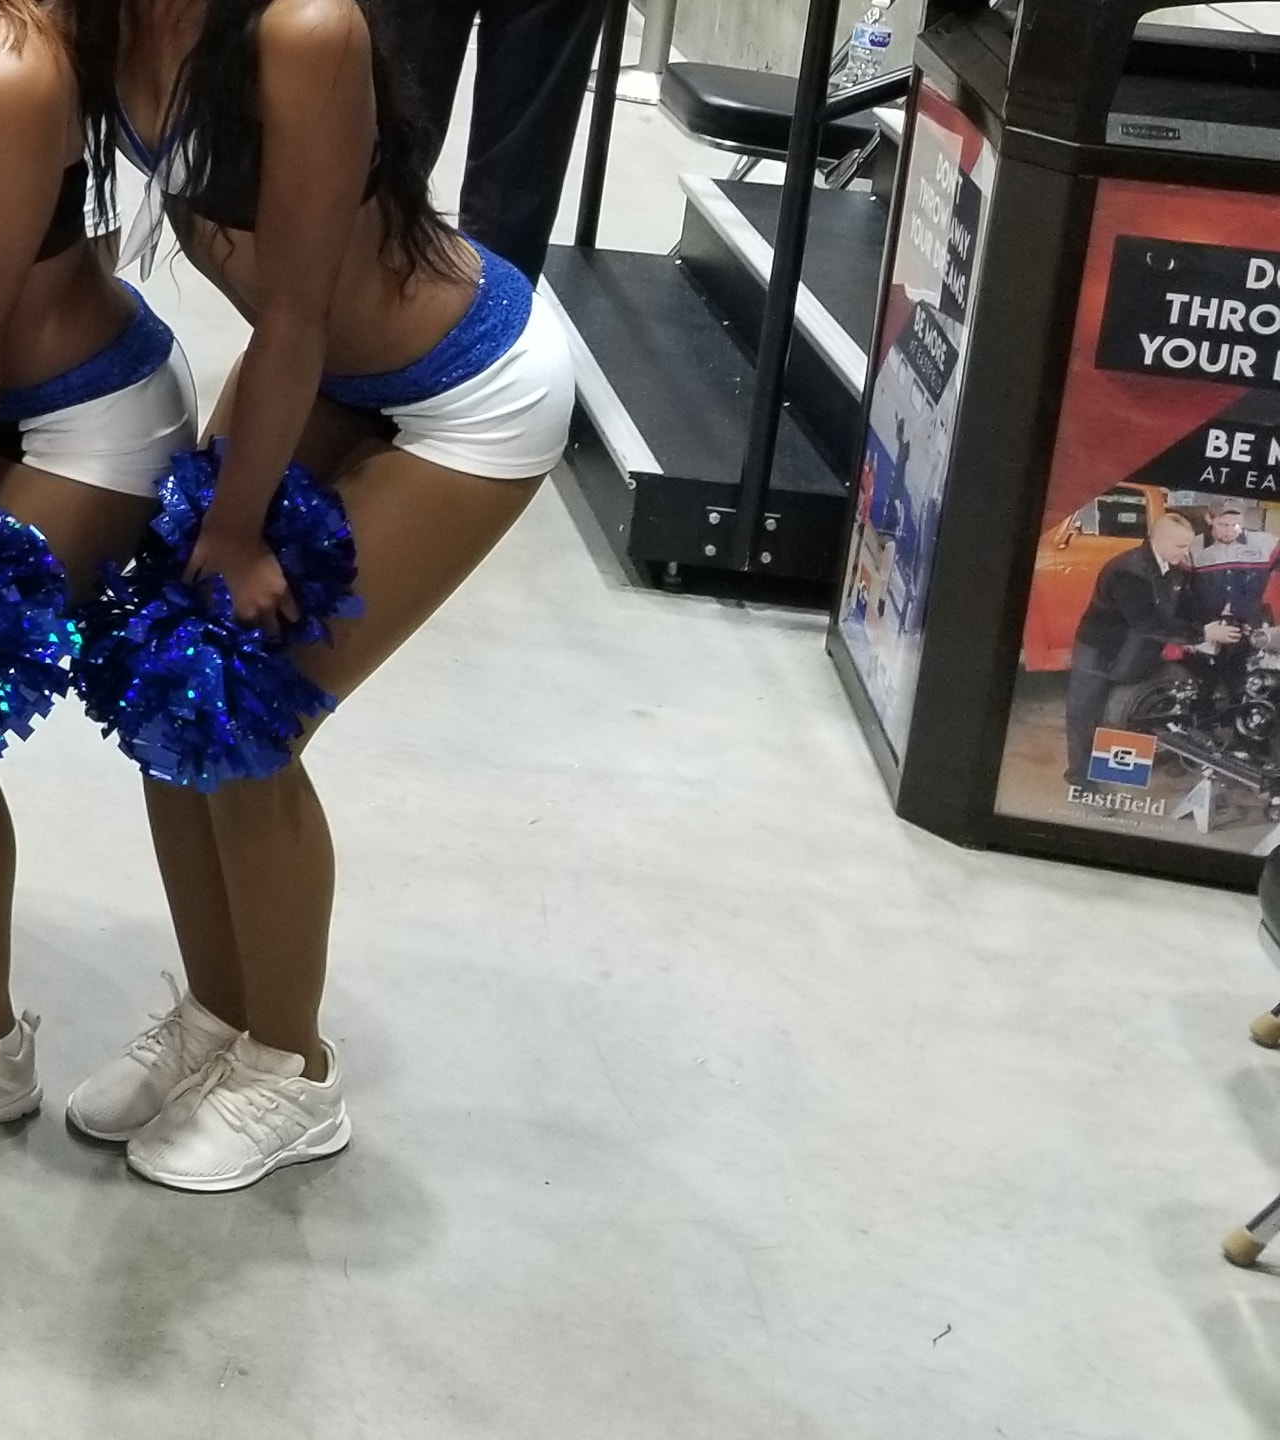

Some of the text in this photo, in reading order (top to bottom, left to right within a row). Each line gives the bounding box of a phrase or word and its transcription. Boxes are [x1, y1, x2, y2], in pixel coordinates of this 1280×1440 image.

[910, 210, 932, 262] YOUR
[919, 176, 971, 261] THROW AWAY
[1246, 258, 1280, 289] D
[913, 305, 947, 372] BE MORE
[1139, 333, 1257, 377] YOUR
[1205, 428, 1256, 463] BE
[1199, 465, 1276, 491] AT EA
[1067, 785, 1166, 817] Eastfield
